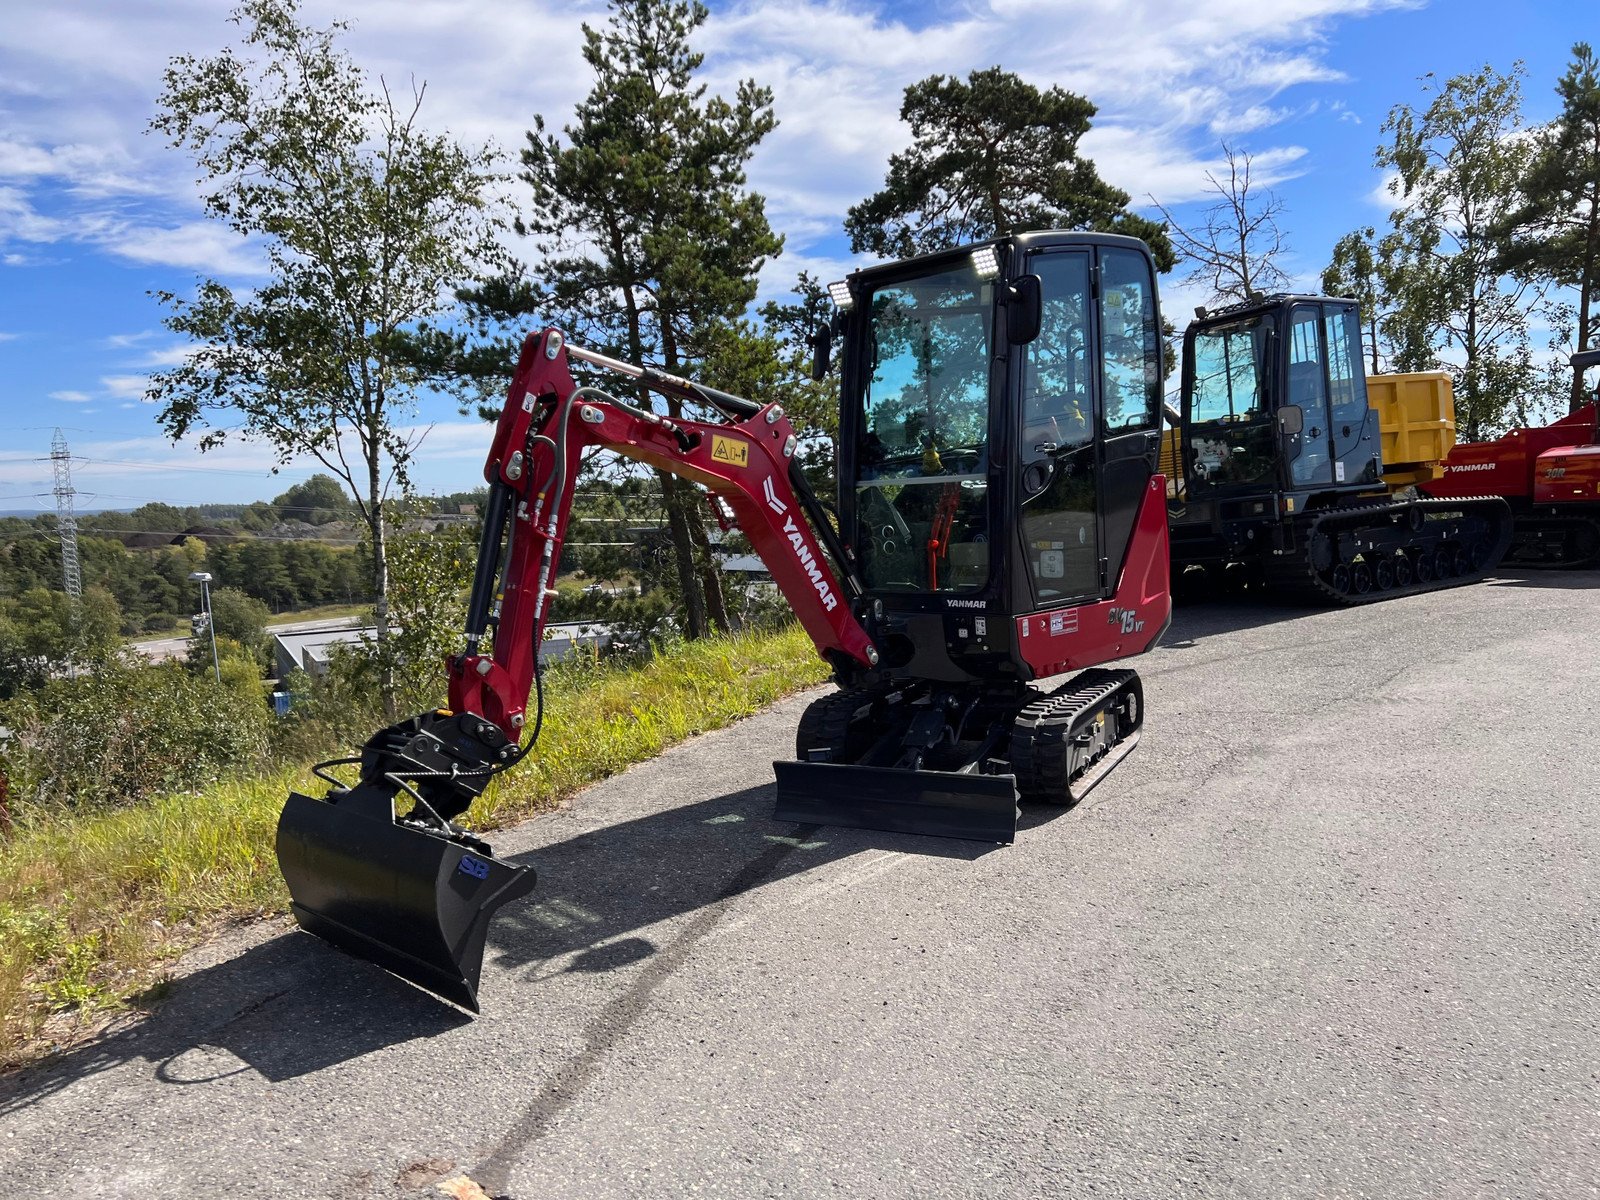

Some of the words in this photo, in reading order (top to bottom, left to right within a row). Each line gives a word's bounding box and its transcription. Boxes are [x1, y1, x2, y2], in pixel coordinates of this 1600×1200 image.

[1450, 462, 1496, 473] YANMAR
[782, 514, 838, 612] YANMAR
[946, 599, 987, 609] YANMAR
